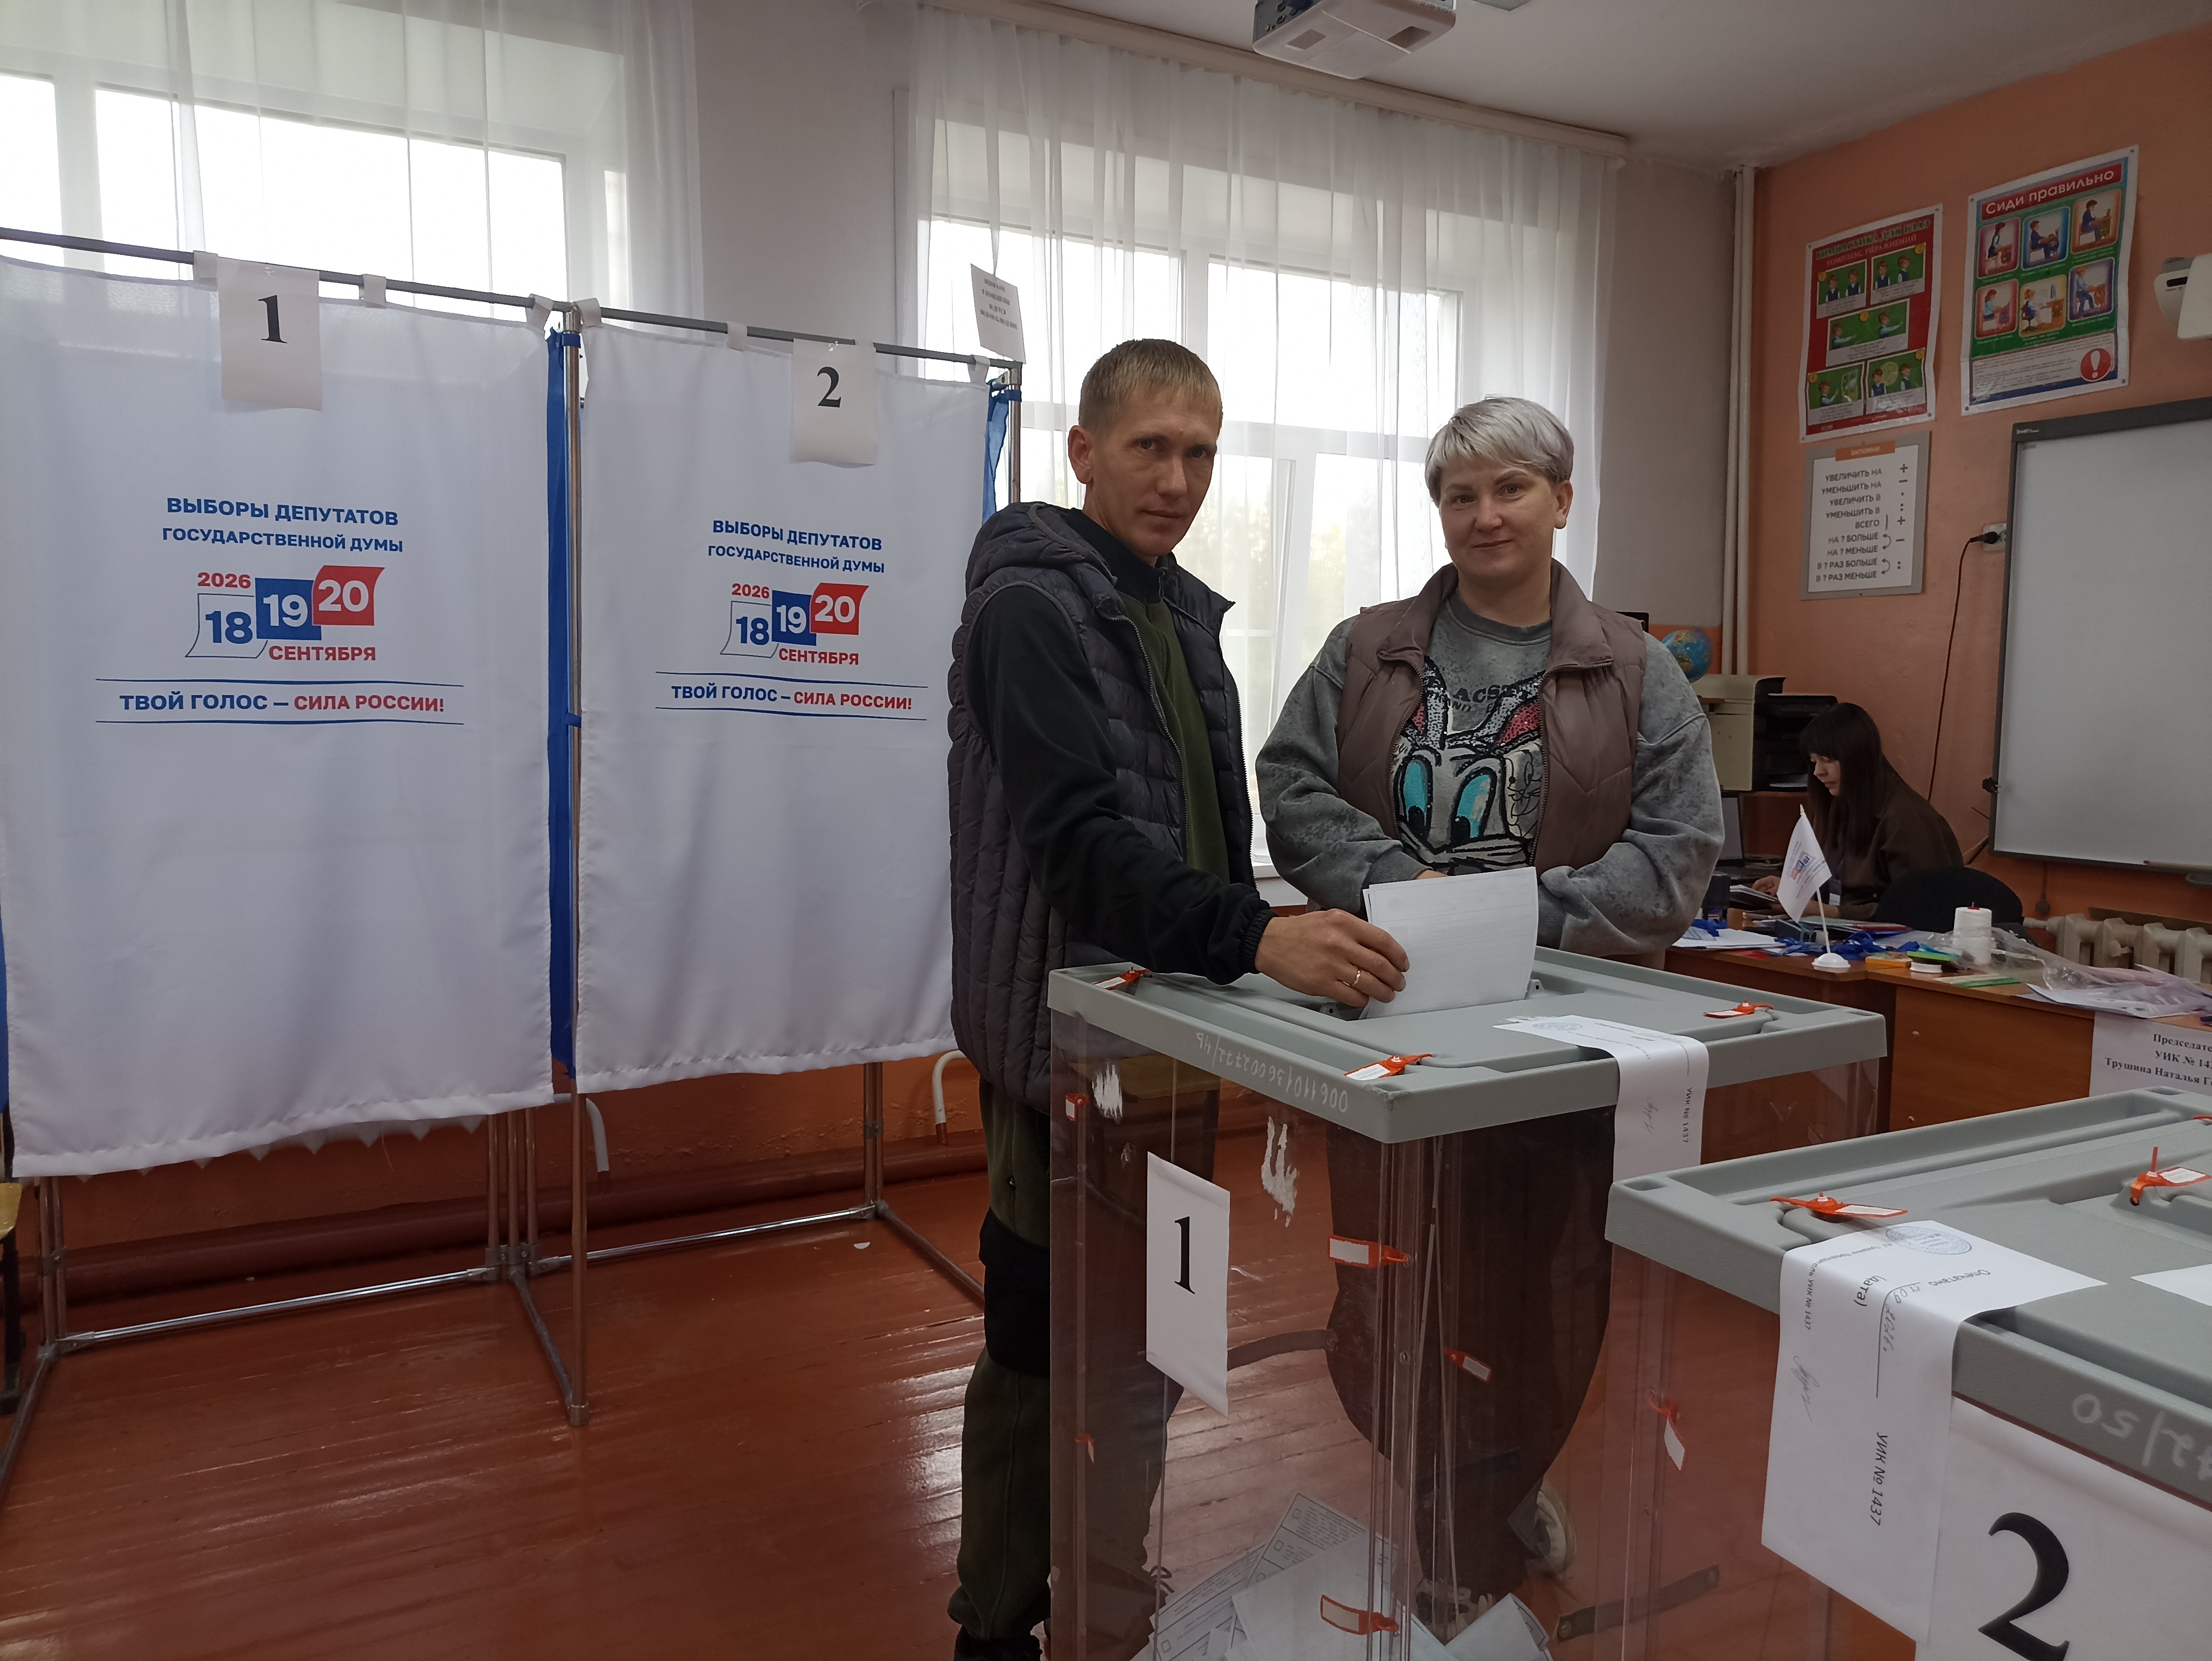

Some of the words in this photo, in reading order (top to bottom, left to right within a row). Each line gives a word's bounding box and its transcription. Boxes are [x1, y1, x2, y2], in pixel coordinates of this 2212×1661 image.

[1986, 196, 2024, 214] Сиди
[2029, 170, 2114, 202] правильно
[258, 295, 288, 344] 1
[817, 366, 841, 408] 2
[1825, 470, 1869, 482] УВЕЛИЧИТЬ
[1821, 483, 1869, 495] УМЕНЬШИТЬ
[1829, 495, 1874, 506] УВЕЛИЧИТЬ
[167, 498, 268, 520] ВЫБОРЫ
[275, 505, 398, 526] ДЕПУТАТОВ
[1825, 508, 1873, 519] УМЕНЬШИТЬ
[1855, 520, 1880, 529] ВСЕГО
[162, 528, 346, 550] ГОСУДАРСТВЕННОЙ
[350, 536, 403, 552] ДУМЫ
[712, 520, 784, 541] ВЫБОРЫ
[787, 531, 882, 551] ДЕПУТАТОВ
[1847, 532, 1878, 543] БОЛЬШЕ
[708, 545, 840, 570] ГОСУДАРСТВЕННОЙ
[842, 559, 885, 573] ДУМЫ
[1845, 545, 1878, 554] МЕНЬШЕ
[1829, 560, 1844, 568] РАЗ
[1846, 558, 1877, 567] БОЛЬШЕ
[198, 572, 251, 589] 2026
[1844, 571, 1877, 580] МЕНЬШЕ
[731, 583, 770, 599] 2026
[205, 610, 253, 644] 18
[263, 594, 308, 628] 19
[318, 580, 369, 613] 20
[736, 616, 770, 646] 18
[776, 604, 807, 634] 19
[815, 595, 856, 623] 20
[268, 645, 376, 661] СЕНТЯБРЯ
[778, 647, 859, 665] СЕНТЯБРЯ
[120, 691, 184, 710] ТВОЙ
[191, 695, 268, 710] ГОЛОС
[294, 695, 350, 711] СИЛА
[355, 695, 444, 713] РОССИИ!
[671, 682, 717, 699] ТВОЙ
[722, 686, 777, 702] ГОЛОС
[794, 691, 836, 706] СИЛА
[840, 694, 912, 710] РОССИИ!
[2155, 1051, 2180, 1063] УИК
[2182, 1056, 2195, 1065] №
[2105, 1057, 2151, 1074] Трушина
[2155, 1067, 2200, 1084] Наталья
[2203, 1077, 2212, 1085] Г
[1684, 1086, 1692, 1105] УИК
[1174, 1216, 1195, 1295] 1
[1928, 1269, 1990, 1286] Опечатано
[1853, 1275, 1887, 1307] (дата)
[1805, 1297, 1812, 1308] №
[1875, 1432, 1888, 1464] УИК
[1873, 1466, 1885, 1485] №
[1869, 1487, 1883, 1526] 1437
[1978, 1512, 2070, 1661] 2
